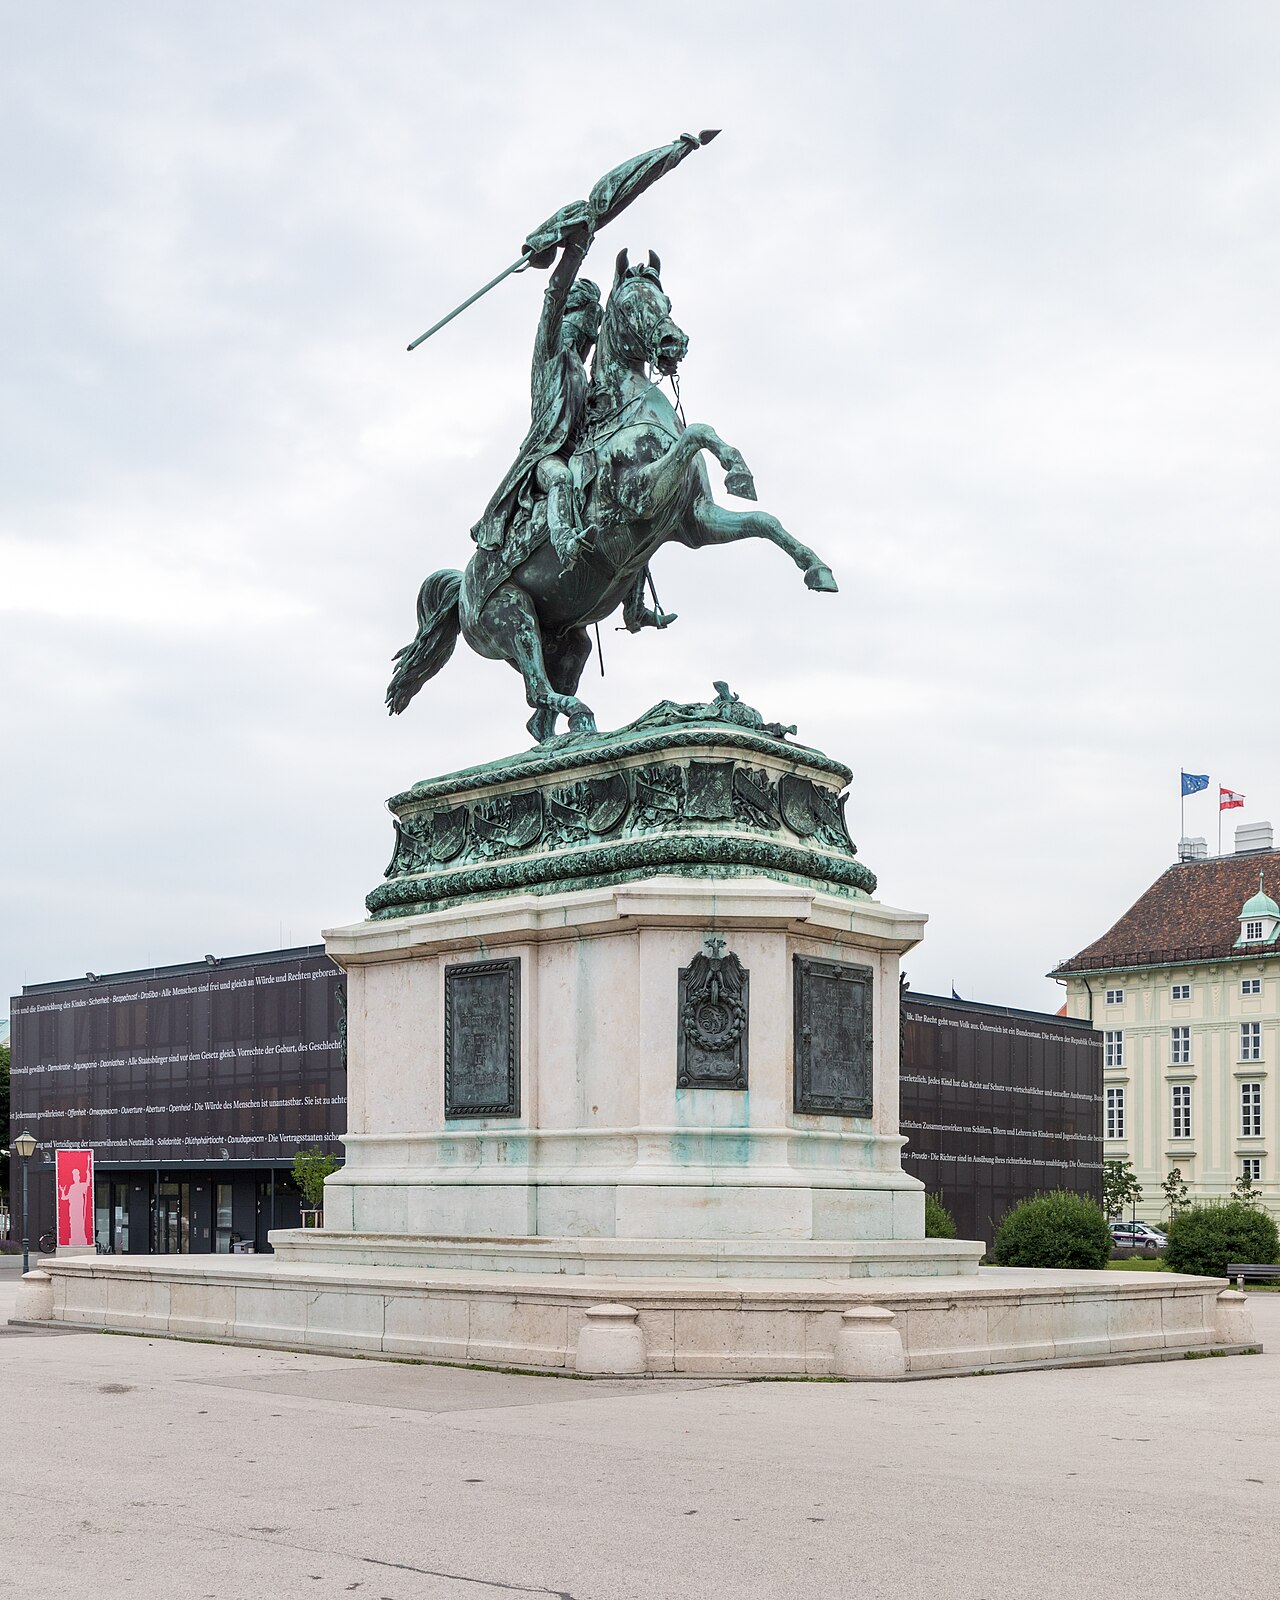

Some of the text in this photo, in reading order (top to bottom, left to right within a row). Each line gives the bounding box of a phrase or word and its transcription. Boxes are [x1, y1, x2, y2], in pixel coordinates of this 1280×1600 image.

[37, 1002, 62, 1012] Entwicklung
[89, 996, 109, 1006] Sicherheit
[161, 988, 171, 997] Alle
[172, 986, 197, 995] Menschen
[198, 983, 208, 992] sind
[210, 982, 219, 990] frei
[220, 981, 230, 989] und
[231, 979, 247, 990] gleich
[256, 975, 275, 985] Würde
[276, 973, 286, 982] und
[288, 971, 311, 981] Rechten
[312, 969, 337, 980] geboren.
[924, 1015, 937, 1024] Recht
[938, 1018, 948, 1026] geht
[960, 1020, 969, 1028] Volk
[980, 1022, 1002, 1033] Österreich
[1050, 1034, 1063, 1042] Farben
[1071, 1037, 1087, 1045] Republik
[29, 1065, 45, 1075] gewählt
[48, 1063, 70, 1071] Demokratie
[128, 1057, 137, 1065] Alle
[138, 1056, 168, 1065] Staatsbürger
[169, 1053, 179, 1062] sind
[189, 1052, 200, 1060] dem
[201, 1051, 218, 1059] Gesetz
[220, 1049, 236, 1060] gleich.
[238, 1047, 264, 1057] Vorrechte
[265, 1046, 274, 1054] der
[275, 1044, 297, 1053] Geburt,
[298, 1042, 308, 1052] des
[928, 1076, 940, 1085] Jedes
[941, 1078, 952, 1086] Kind
[969, 1081, 982, 1089] Recht
[990, 1083, 1004, 1091] Schutz
[168, 1103, 191, 1113] Openheid
[204, 1101, 222, 1110] Würde
[223, 1101, 232, 1109] des
[233, 1100, 260, 1108] Menschen
[269, 1097, 303, 1107] unantastbar.
[305, 1097, 313, 1105] Sie
[923, 1122, 962, 1132] Zusammenwirken
[1016, 1128, 1031, 1136] Lehrern
[53, 1140, 80, 1149] Verteidigung
[158, 1137, 181, 1145] Solidarität
[268, 1134, 278, 1142] Die
[279, 1134, 323, 1144] Vertragsstaaten
[940, 1153, 956, 1161] Richter
[973, 1155, 994, 1165] Ausübung
[1006, 1157, 1031, 1165] richterlichen
